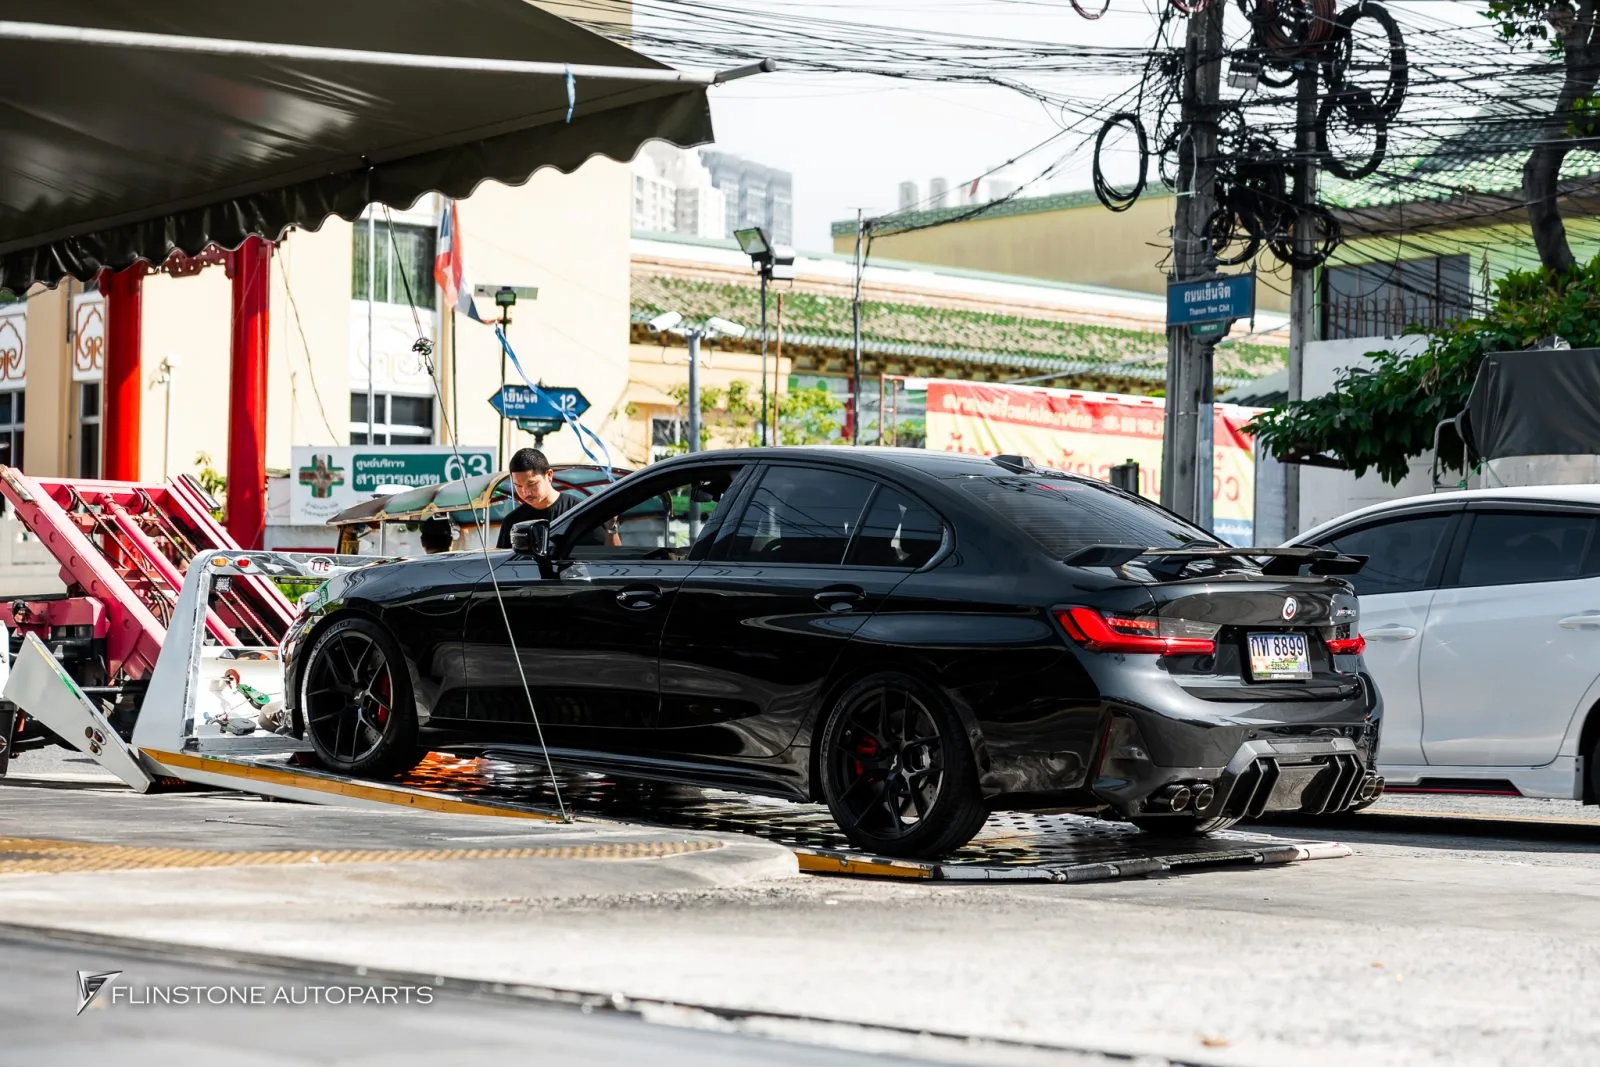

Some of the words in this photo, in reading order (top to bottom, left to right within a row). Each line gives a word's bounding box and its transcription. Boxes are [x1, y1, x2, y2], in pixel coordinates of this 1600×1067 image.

[1184, 282, 1231, 303] ถนนเย็นจิต
[559, 394, 577, 411] 12
[356, 457, 405, 471] ศูนย์บริการ
[444, 455, 487, 482] 63
[356, 473, 440, 485] สาธารณสข
[311, 560, 330, 571] TTE
[1273, 636, 1304, 656] 8899
